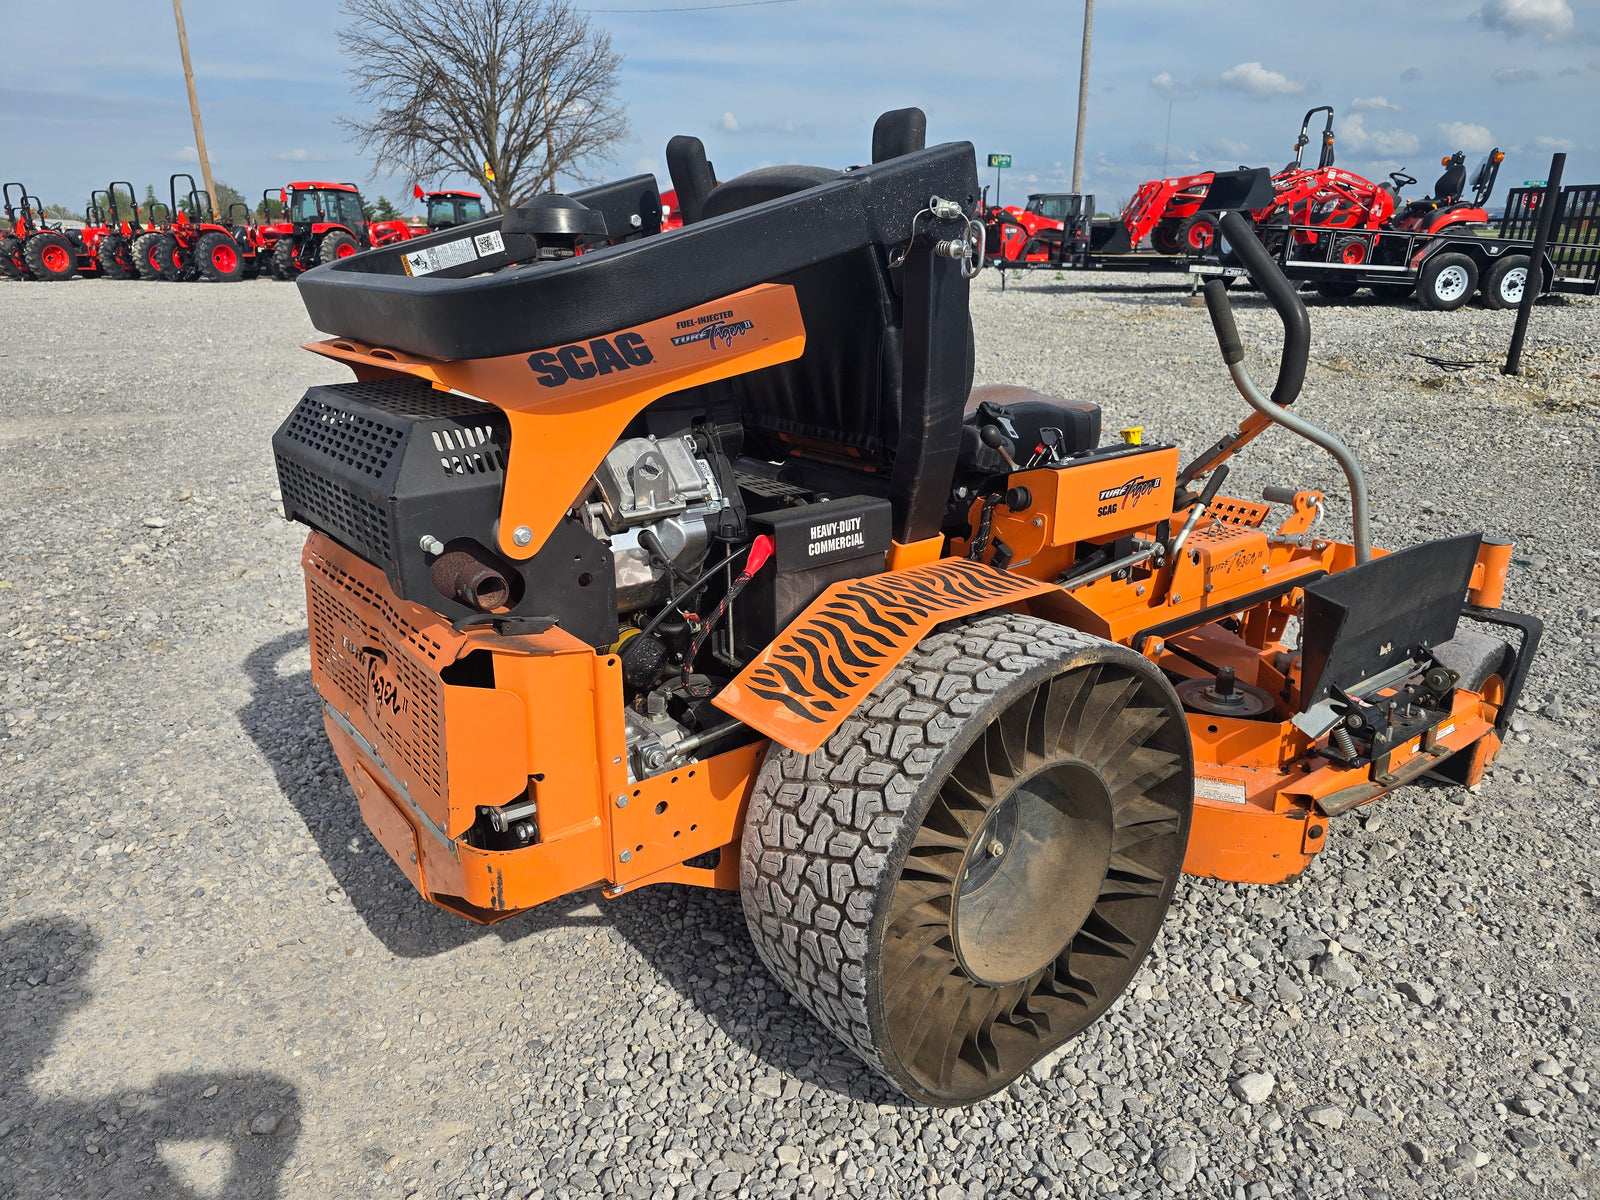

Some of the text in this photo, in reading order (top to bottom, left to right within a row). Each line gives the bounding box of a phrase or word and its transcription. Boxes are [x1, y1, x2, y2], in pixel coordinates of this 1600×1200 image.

[676, 310, 734, 329] FUEL-INJECTED
[673, 320, 752, 351] TURF Tiger II
[526, 331, 655, 388] SCAG
[1099, 485, 1127, 501] TURF
[1121, 475, 1153, 510] Tiger
[1097, 503, 1118, 517] SCAG
[810, 516, 861, 540] HEAVY-DUTY
[808, 532, 864, 556] COMMERCIAL
